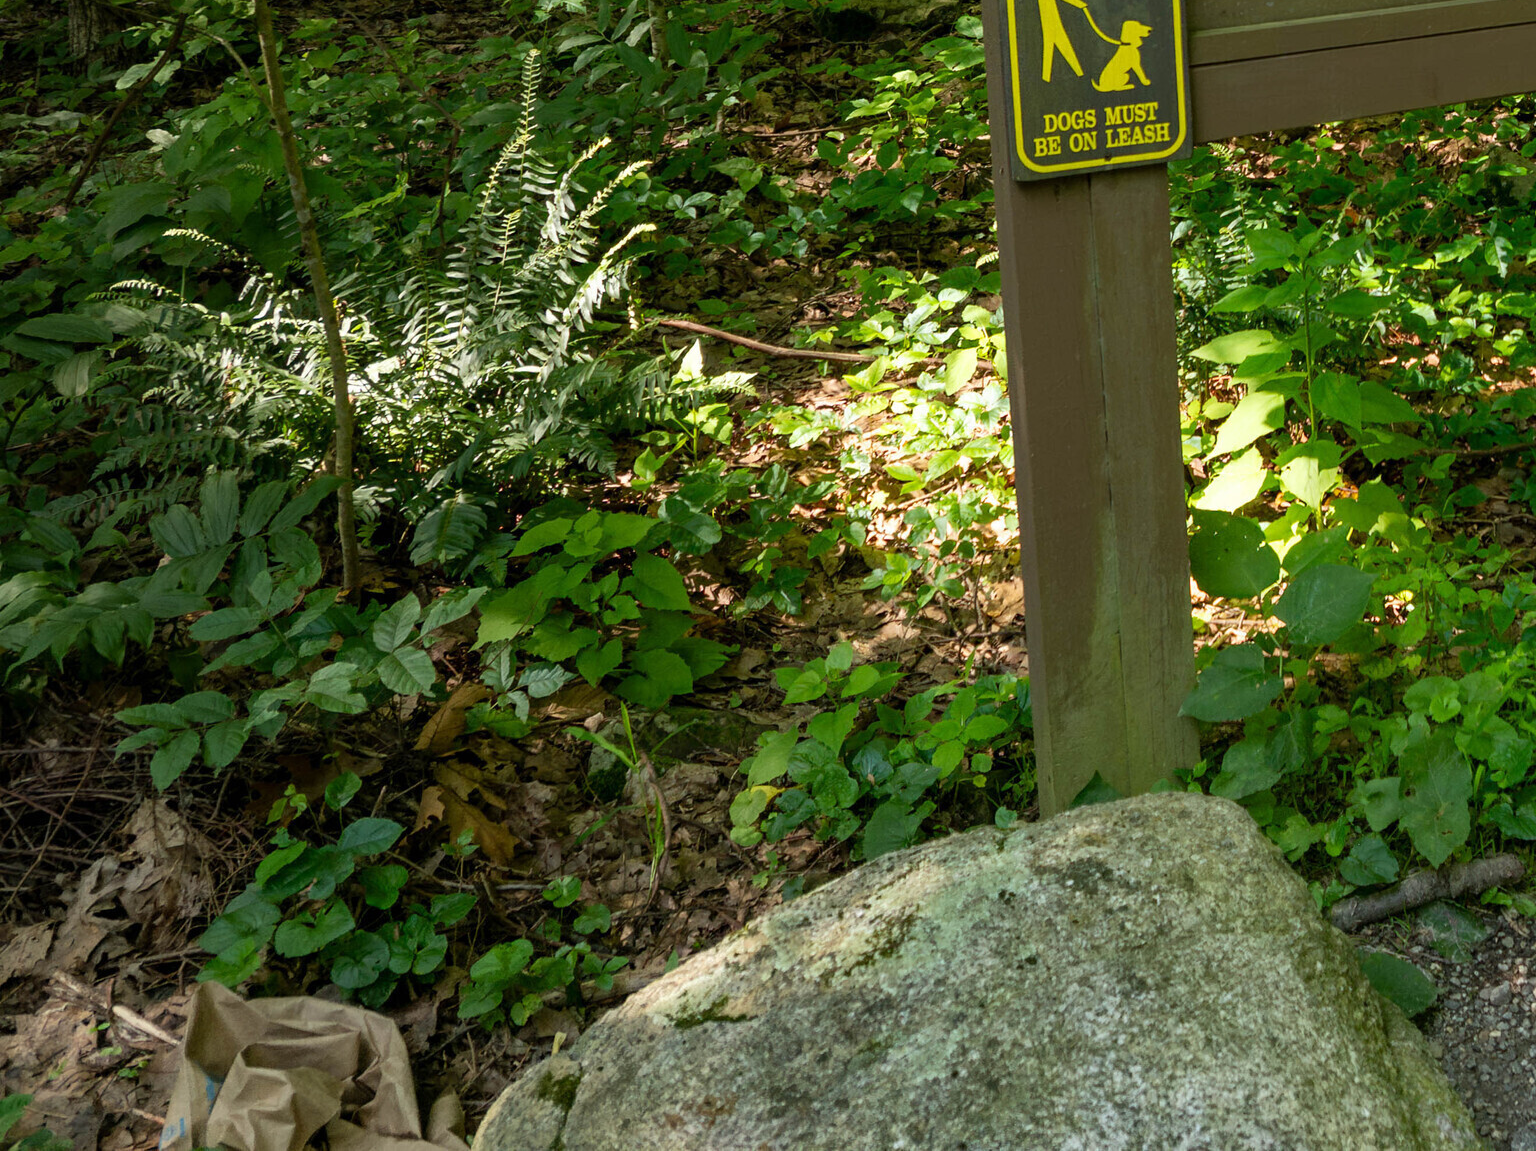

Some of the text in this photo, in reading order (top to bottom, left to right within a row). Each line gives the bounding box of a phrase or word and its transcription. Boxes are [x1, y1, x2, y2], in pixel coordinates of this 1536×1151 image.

[1044, 102, 1158, 133] DOGS MUST
[1034, 123, 1170, 157] BE ON LEASH
